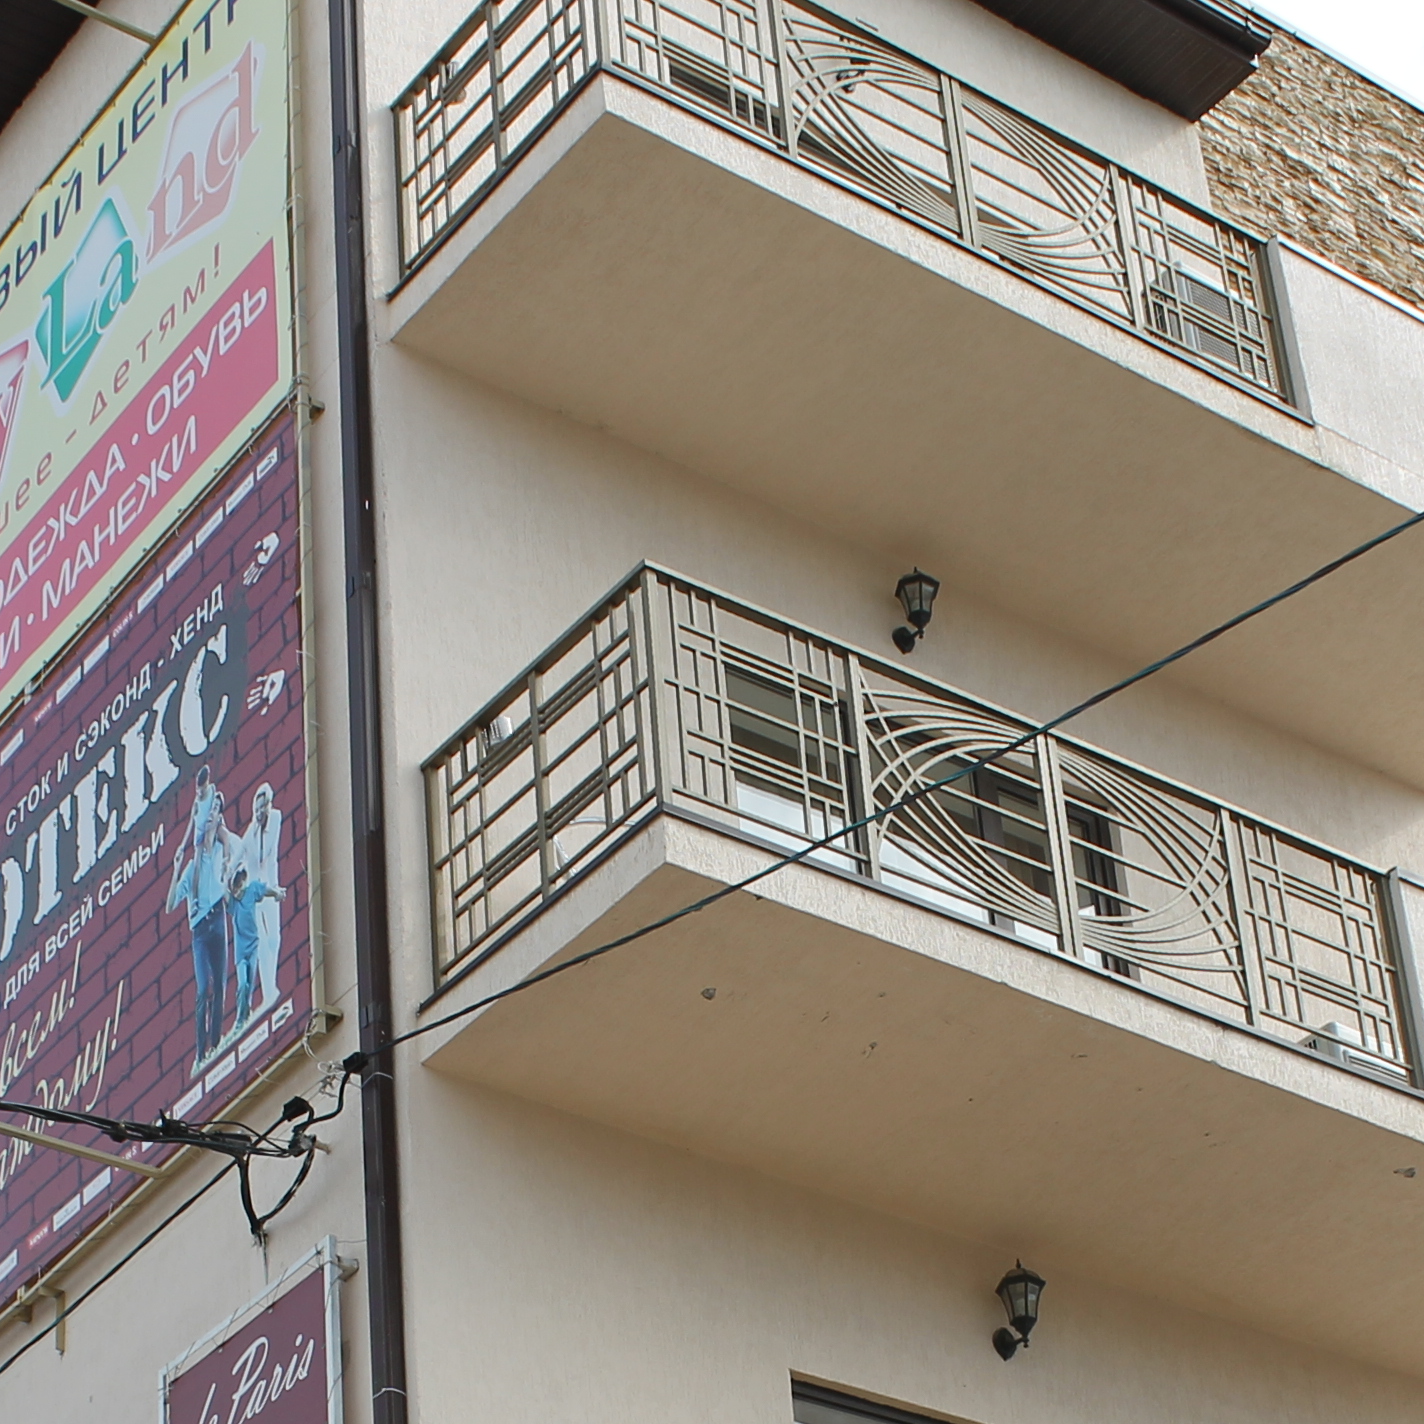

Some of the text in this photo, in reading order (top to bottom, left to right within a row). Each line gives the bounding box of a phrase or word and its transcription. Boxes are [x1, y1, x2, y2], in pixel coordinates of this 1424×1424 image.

[89, 242, 221, 426] детям!
[145, 284, 268, 436] ОБУВЬ
[41, 414, 198, 622] МАНЕЖИ
[5, 769, 52, 836] СТОК
[56, 752, 69, 784] И
[74, 661, 152, 762] СЭКОНД
[169, 582, 224, 661] ХЕНД
[3, 950, 40, 1009] ДЛЯ
[44, 893, 94, 964] ВСЕЙ
[97, 822, 165, 907] СЕМЬИ
